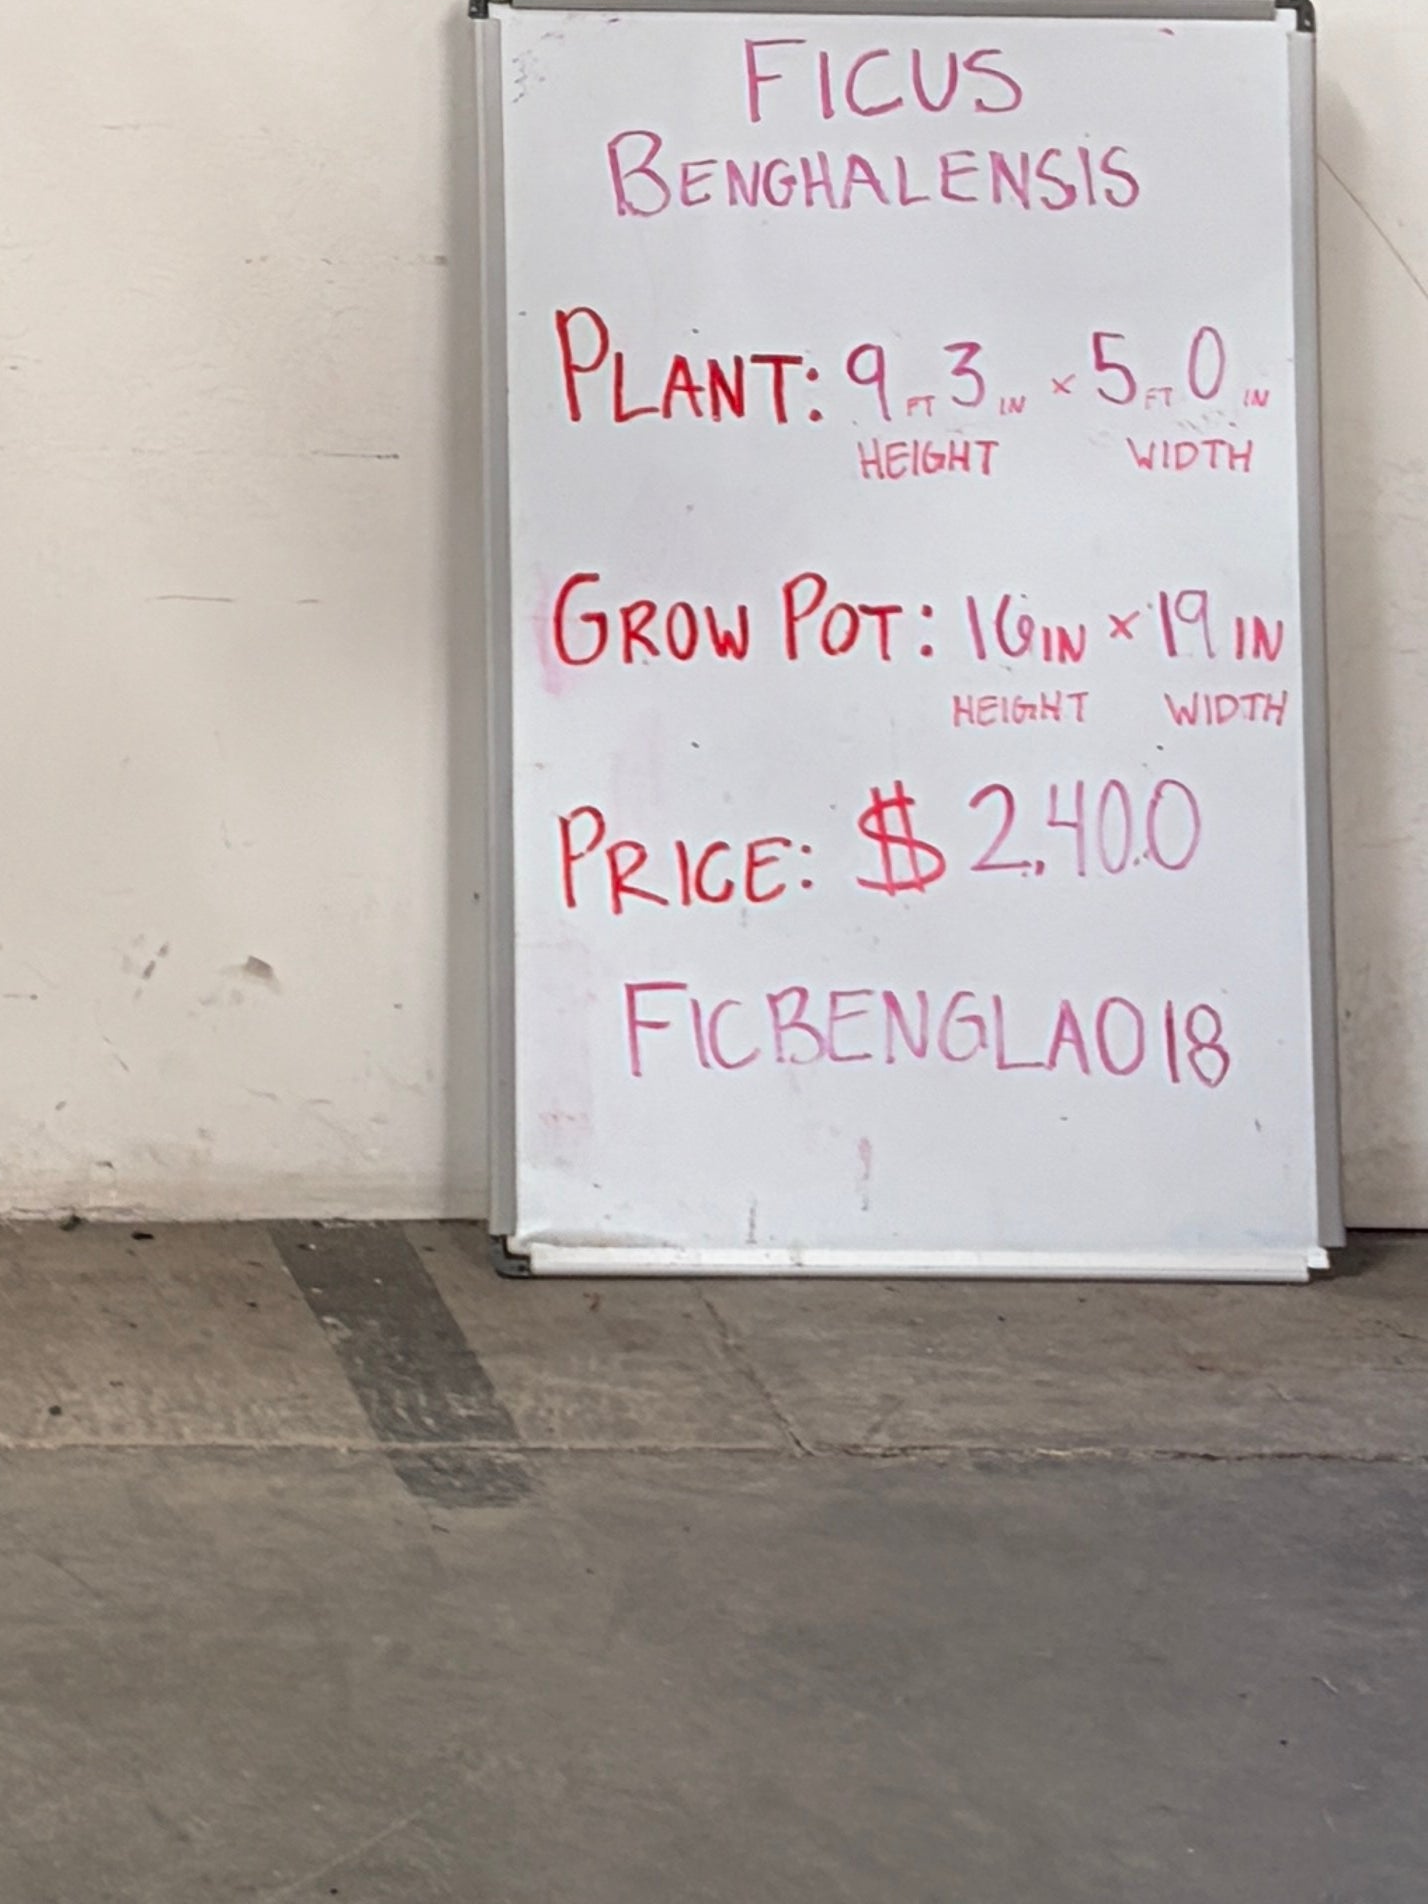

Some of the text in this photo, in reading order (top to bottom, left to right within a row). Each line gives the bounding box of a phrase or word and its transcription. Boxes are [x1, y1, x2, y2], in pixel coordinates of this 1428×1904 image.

[744, 38, 1023, 123] FICUS
[607, 129, 1140, 217] BENGHALENSIS
[553, 307, 823, 425] PLANT:
[857, 437, 1254, 481] HEIGHT WIDTH
[551, 571, 751, 668] GROW
[781, 570, 935, 663] POT:
[951, 689, 1289, 728] HEIGHT WIDTH
[557, 804, 815, 917] PRICE:
[624, 981, 1232, 1087] FICBENGLA018
